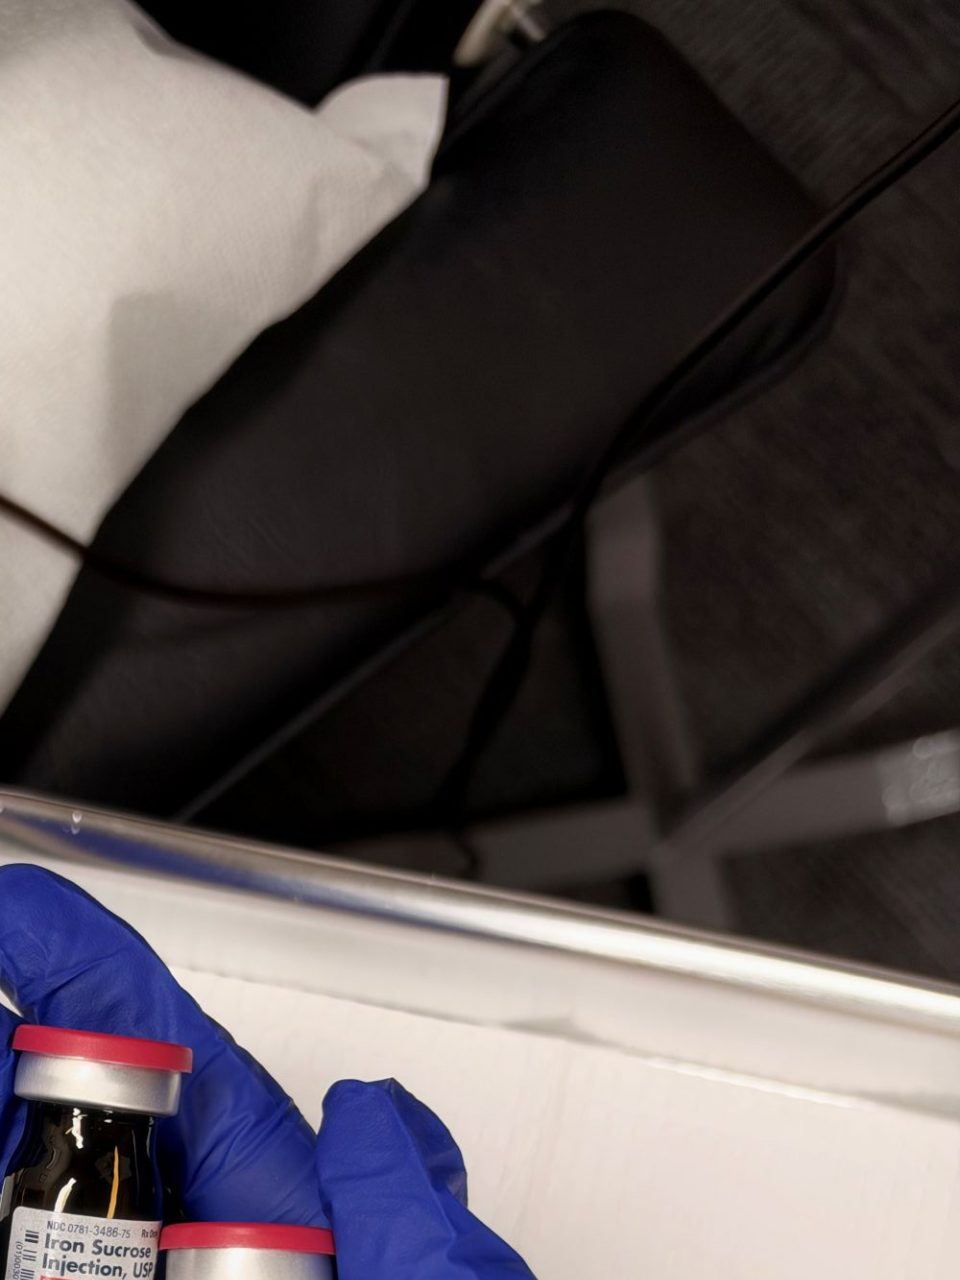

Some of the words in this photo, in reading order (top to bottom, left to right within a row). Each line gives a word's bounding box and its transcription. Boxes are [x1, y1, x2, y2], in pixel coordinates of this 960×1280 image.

[47, 1221, 66, 1231] NDC
[67, 1224, 131, 1238] 0781-3486-75
[141, 1229, 149, 1238] Rx
[45, 1233, 84, 1253] Iron
[91, 1239, 151, 1258] Sucrose
[42, 1253, 127, 1280] Injection,
